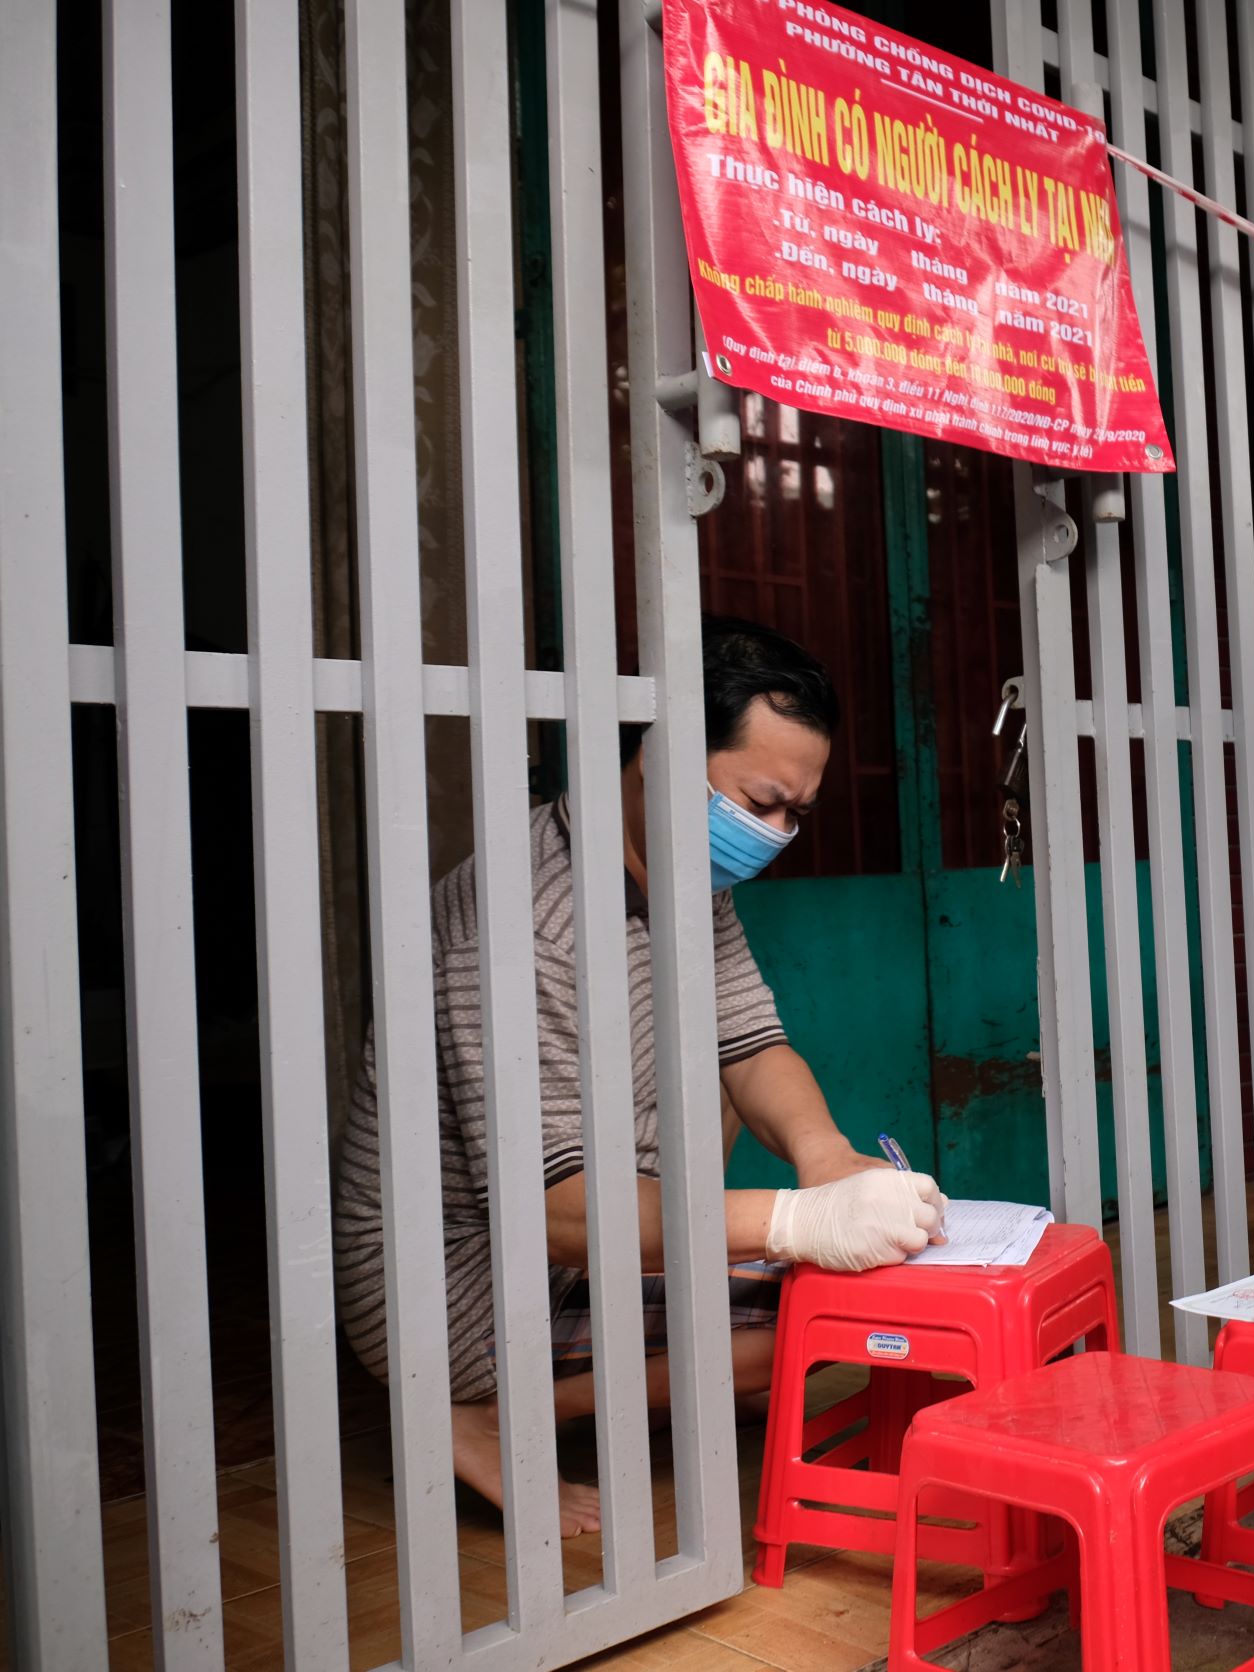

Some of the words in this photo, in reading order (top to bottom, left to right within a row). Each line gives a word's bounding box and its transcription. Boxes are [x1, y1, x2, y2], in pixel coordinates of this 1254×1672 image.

[778, 0, 867, 43] PHÒNG
[873, 36, 954, 81] CHỐNG
[959, 71, 1012, 104] DỊCH
[1017, 96, 1105, 145] COVID-19
[786, 21, 891, 75] PHƯỜNG
[897, 66, 943, 97] TÂN
[948, 87, 999, 120] THỜI
[1004, 111, 1060, 144] NHẤT
[704, 51, 759, 142] GIA
[762, 58, 830, 167] ĐÌNH
[834, 88, 870, 180] CÓ
[873, 111, 949, 208] NGƯỜI
[953, 133, 1015, 230] CÁCH
[1016, 165, 1039, 239] LY
[1043, 176, 1080, 264] TẠI
[706, 153, 780, 190] Thực
[787, 172, 846, 209] hiện
[851, 197, 909, 233] cách
[914, 215, 942, 245] ly:
[823, 223, 879, 256] ngày
[911, 250, 968, 285] tháng
[994, 280, 1041, 305] năm
[1045, 292, 1089, 319] 2021
[841, 258, 899, 292] ngày
[922, 281, 979, 316] tháng
[999, 307, 1045, 334] năm
[1049, 320, 1094, 347] 2021
[697, 257, 741, 294] Không
[745, 273, 785, 302] chấp
[788, 284, 823, 309] hành
[825, 295, 874, 324] nghiêm
[877, 308, 901, 335] quy
[903, 313, 931, 340] định
[1119, 373, 1146, 393] tiền
[722, 335, 747, 356] (Quy
[749, 347, 775, 366] định
[927, 386, 941, 401] 11
[943, 389, 969, 407] Nghị
[827, 328, 842, 349] từ
[845, 332, 907, 366] 5.000.000
[1029, 379, 1056, 405] đồng
[770, 374, 793, 391] của
[795, 379, 833, 398] Chính
[834, 388, 857, 404] phủ
[859, 393, 881, 410] quy
[882, 398, 907, 415] định
